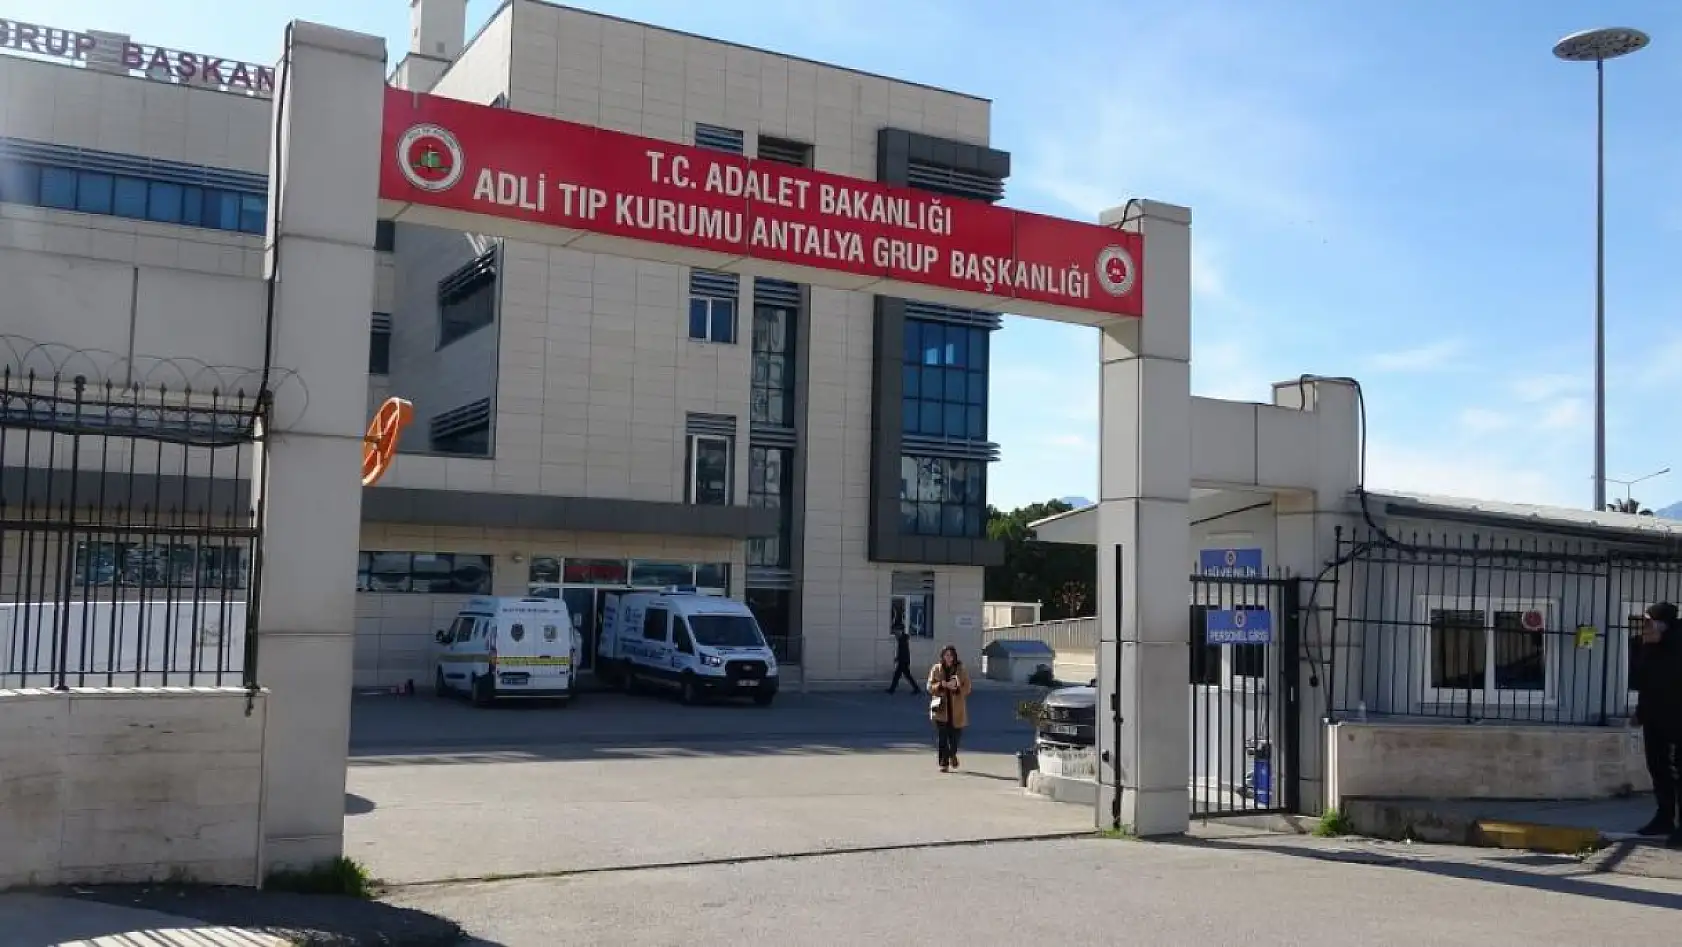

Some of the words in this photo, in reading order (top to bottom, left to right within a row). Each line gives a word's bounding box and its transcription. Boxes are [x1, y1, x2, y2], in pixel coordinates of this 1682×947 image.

[473, 167, 546, 212] ADLİ
[558, 183, 607, 219] TIP
[616, 193, 742, 244] KURUMU
[751, 216, 866, 263] ANTALYA
[873, 236, 939, 273] GRUP
[951, 250, 1090, 299] BAŞKANLIĞI
[646, 149, 697, 189] T.C.
[705, 162, 811, 209] ADALET
[819, 184, 952, 236] BAKANLIĞI
